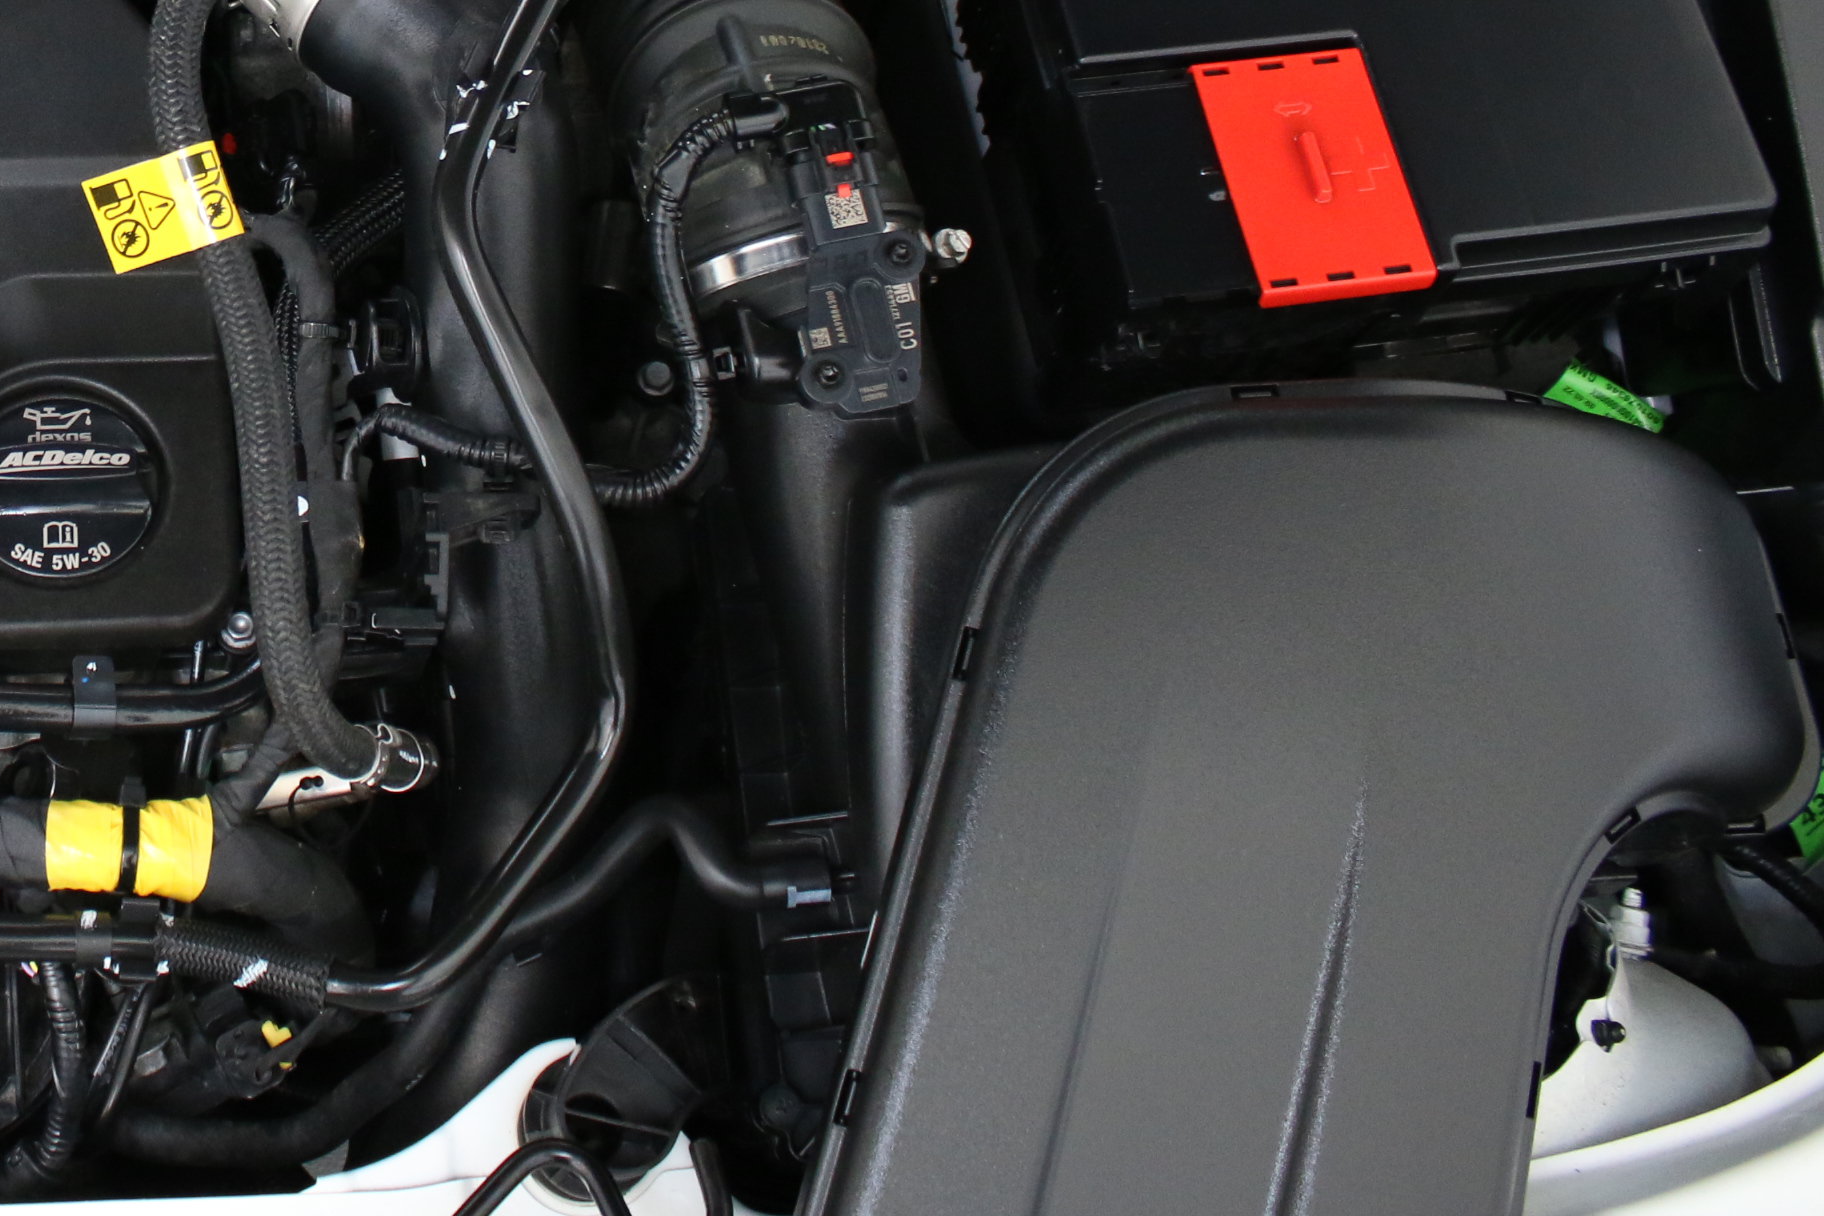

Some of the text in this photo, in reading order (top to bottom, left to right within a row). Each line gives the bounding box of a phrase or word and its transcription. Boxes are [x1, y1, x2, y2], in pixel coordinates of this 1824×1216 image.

[893, 284, 911, 304] GM
[10, 541, 112, 571] SAE 5W-30
